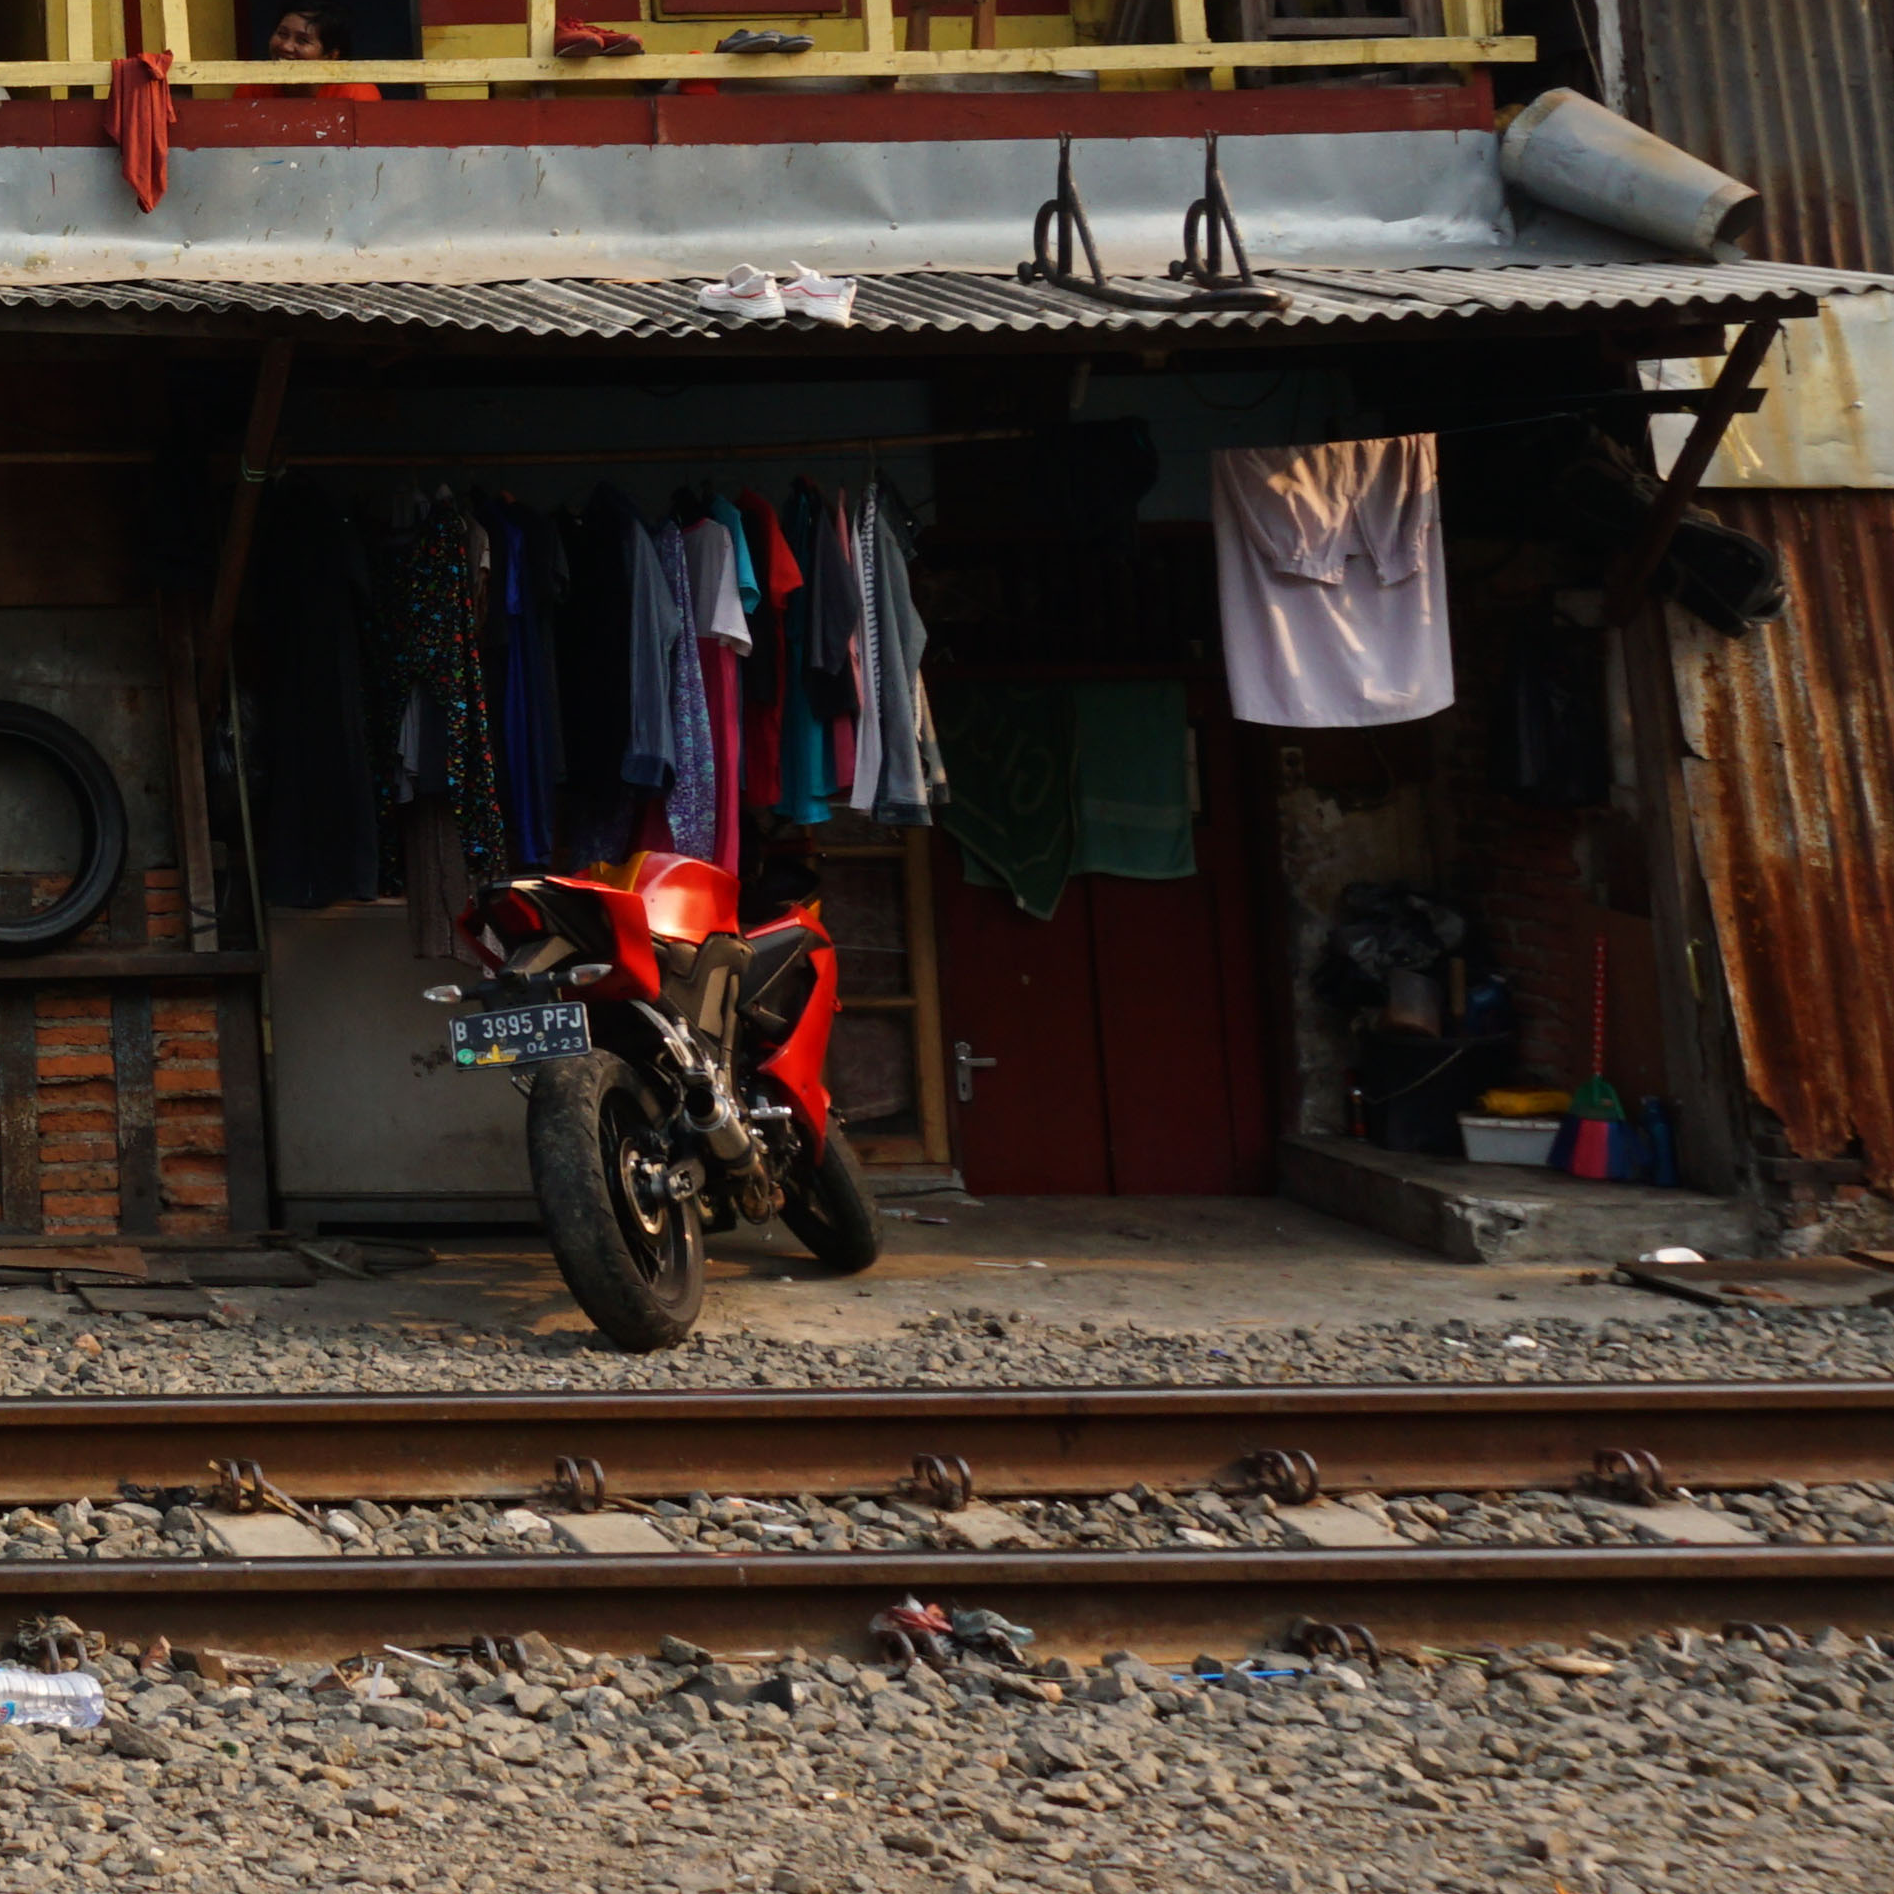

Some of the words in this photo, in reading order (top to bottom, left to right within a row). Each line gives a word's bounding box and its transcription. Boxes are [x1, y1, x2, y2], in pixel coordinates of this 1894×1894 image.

[455, 1021, 468, 1042] B
[482, 1012, 534, 1039] 3995
[542, 1007, 582, 1031] PFJ
